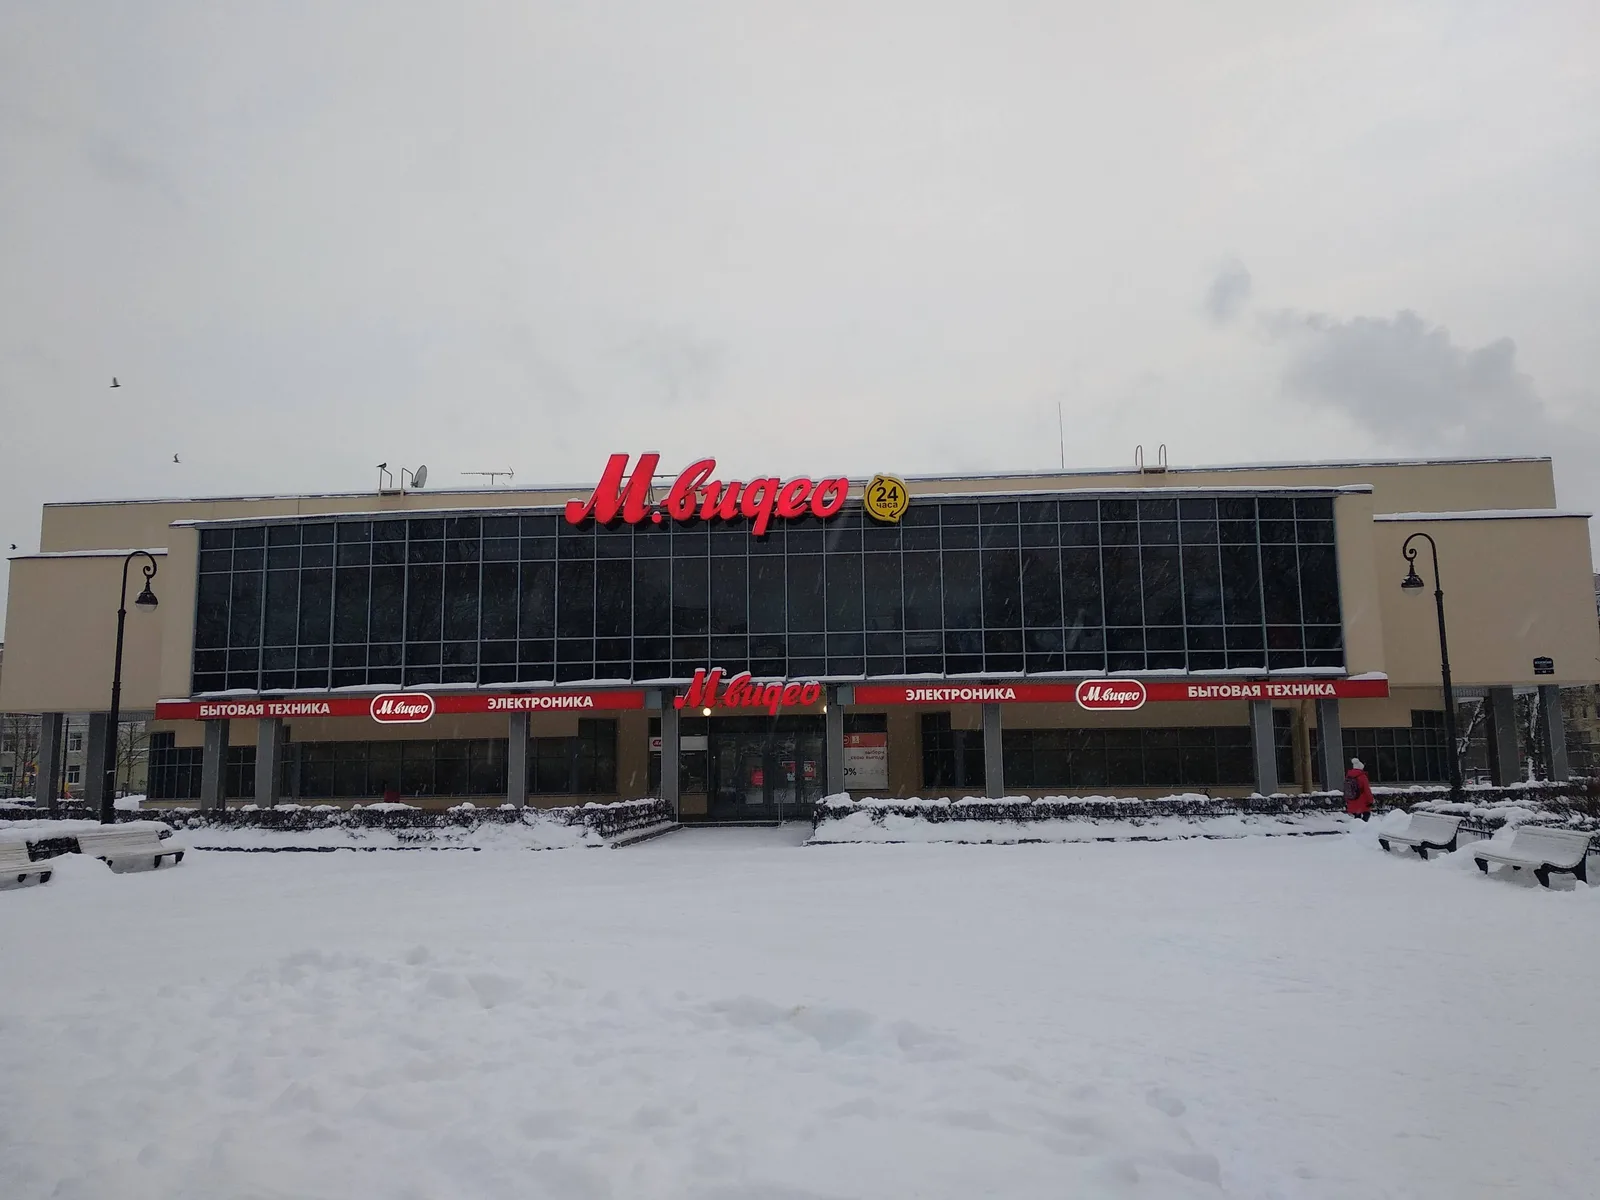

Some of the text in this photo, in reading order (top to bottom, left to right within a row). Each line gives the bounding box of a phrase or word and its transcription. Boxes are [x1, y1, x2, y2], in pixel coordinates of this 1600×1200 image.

[564, 452, 850, 537] М.видео
[876, 486, 899, 502] 24
[905, 688, 1016, 701] ЭЛЕКТРОНИКА
[1082, 686, 1140, 704] М.видео
[1188, 683, 1336, 698] БЫТОВАЯ ТЕХНИКА
[200, 702, 331, 717] БЫТОВАЯ ТЕХНИКА
[376, 700, 429, 717] М.видео
[487, 695, 594, 710] ЭЛЕКТРОНИКА
